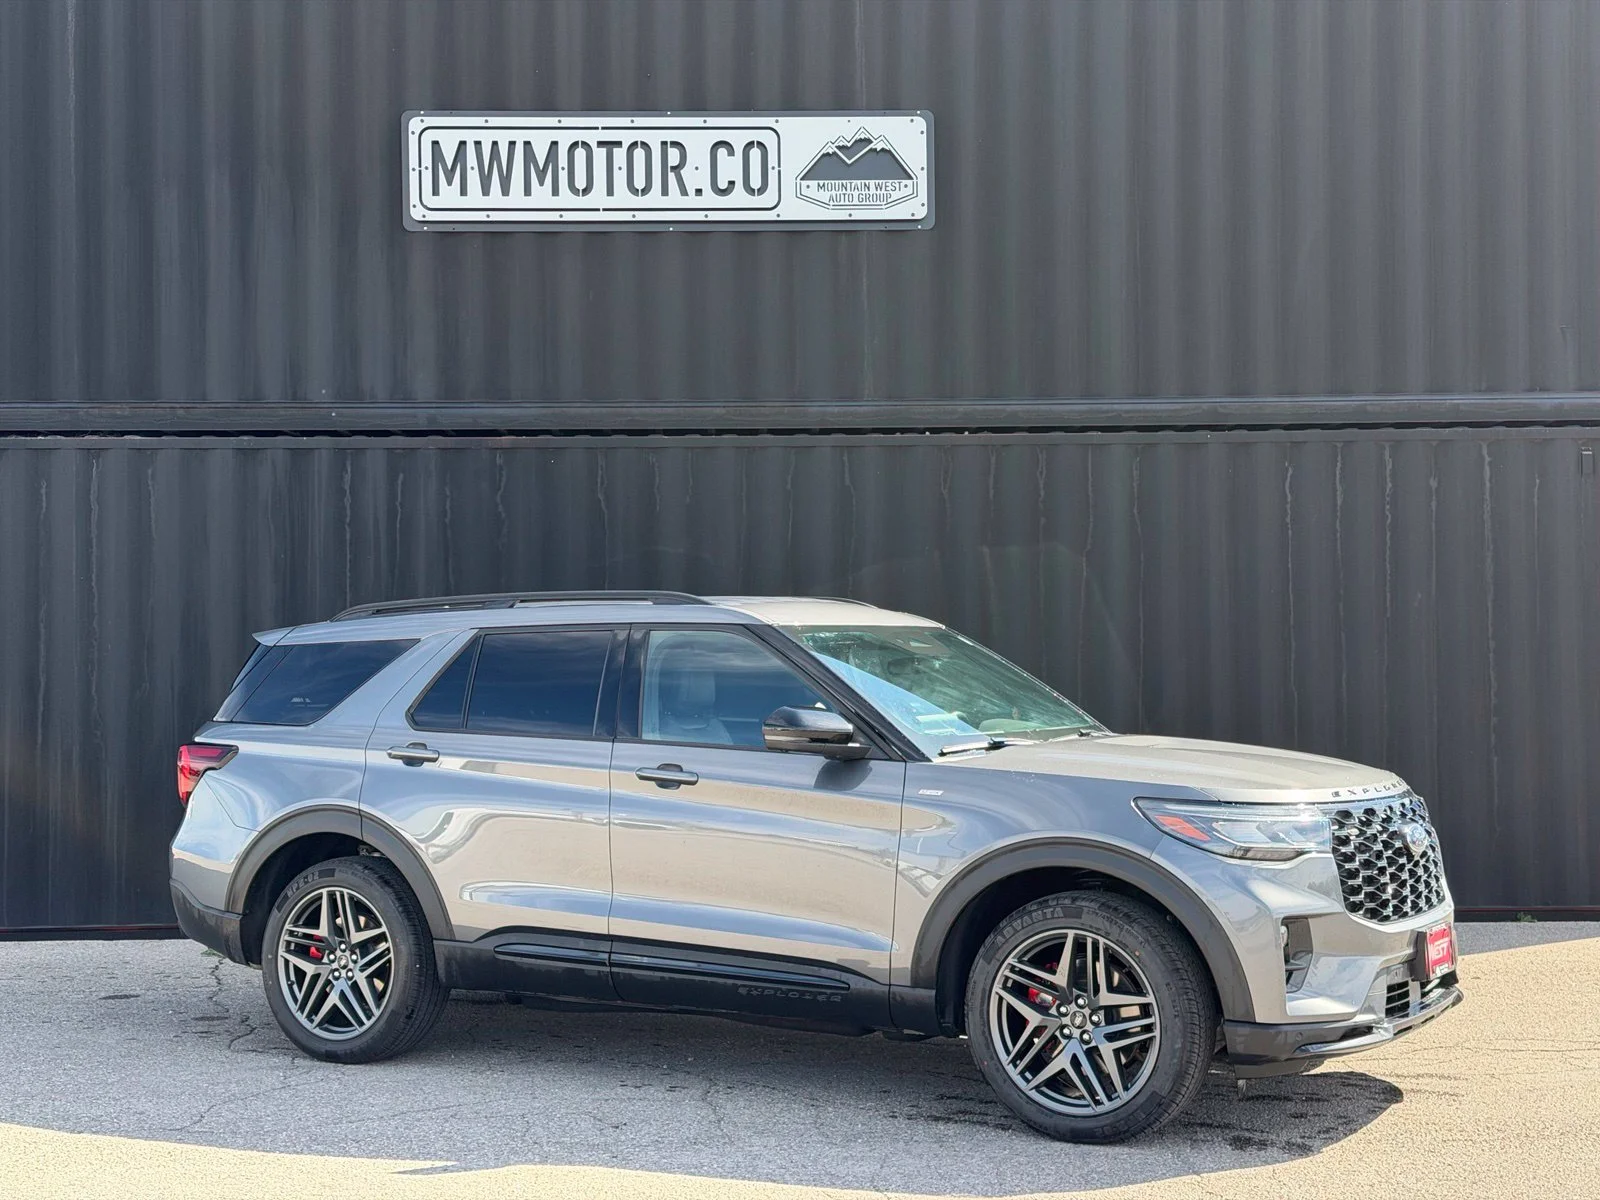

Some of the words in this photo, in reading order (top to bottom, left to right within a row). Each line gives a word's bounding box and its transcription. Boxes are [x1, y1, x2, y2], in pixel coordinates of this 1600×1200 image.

[431, 140, 768, 197] MWMOTOR.CO
[817, 182, 870, 192] MOUNTAIN
[874, 181, 902, 192] WEST
[828, 193, 854, 203] AUTO
[858, 192, 892, 203] GROUP
[996, 907, 1064, 946] ADVANTA
